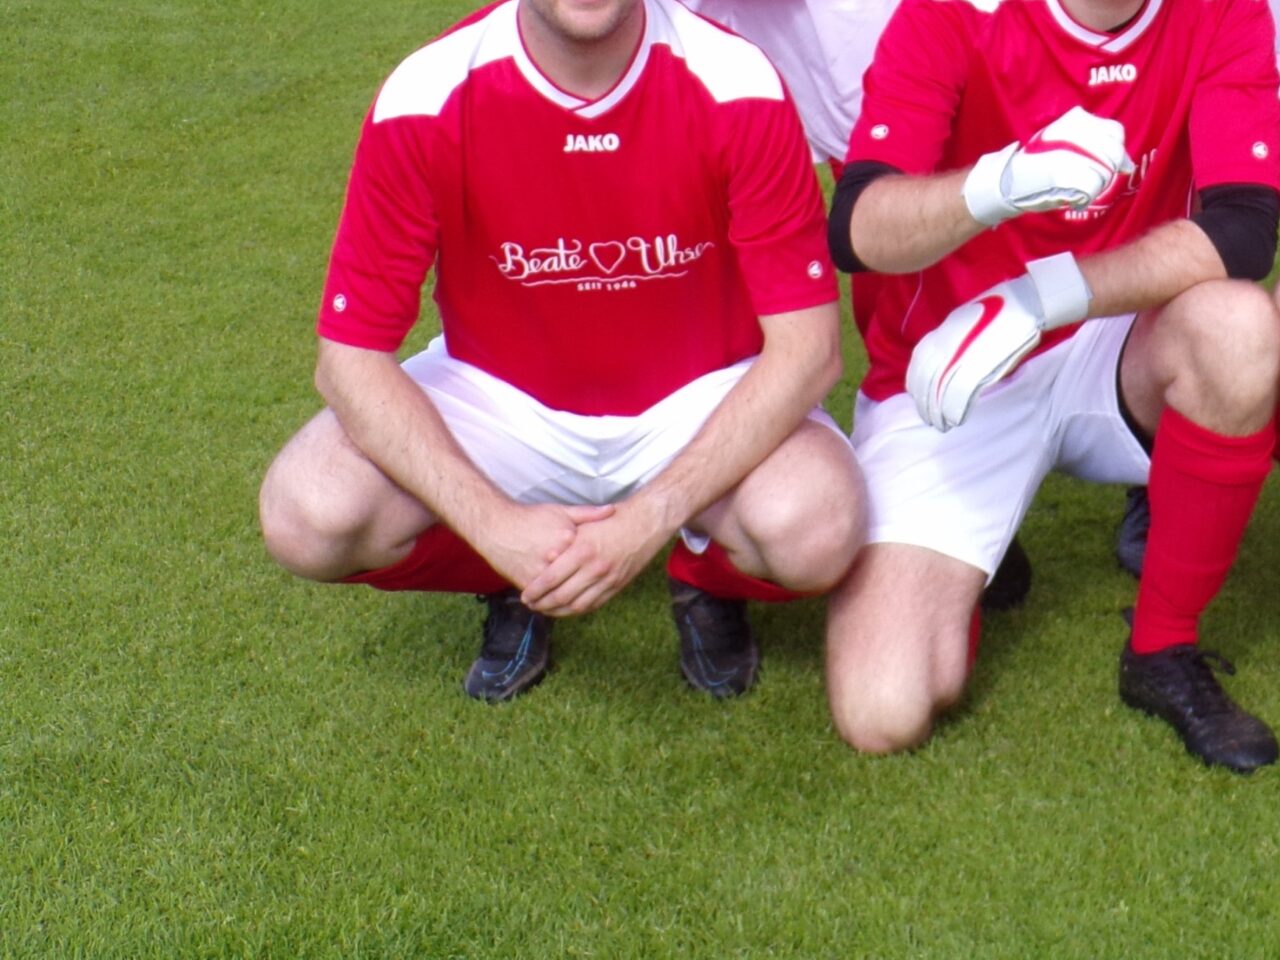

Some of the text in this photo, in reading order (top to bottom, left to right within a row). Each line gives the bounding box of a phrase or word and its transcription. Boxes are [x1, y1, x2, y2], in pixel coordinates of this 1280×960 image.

[1088, 63, 1137, 86] JAKO
[563, 133, 620, 153] JAKO
[1064, 211, 1089, 221] SEIT
[488, 233, 715, 279] Beate Uhse
[577, 280, 637, 291] SEIT 1946
